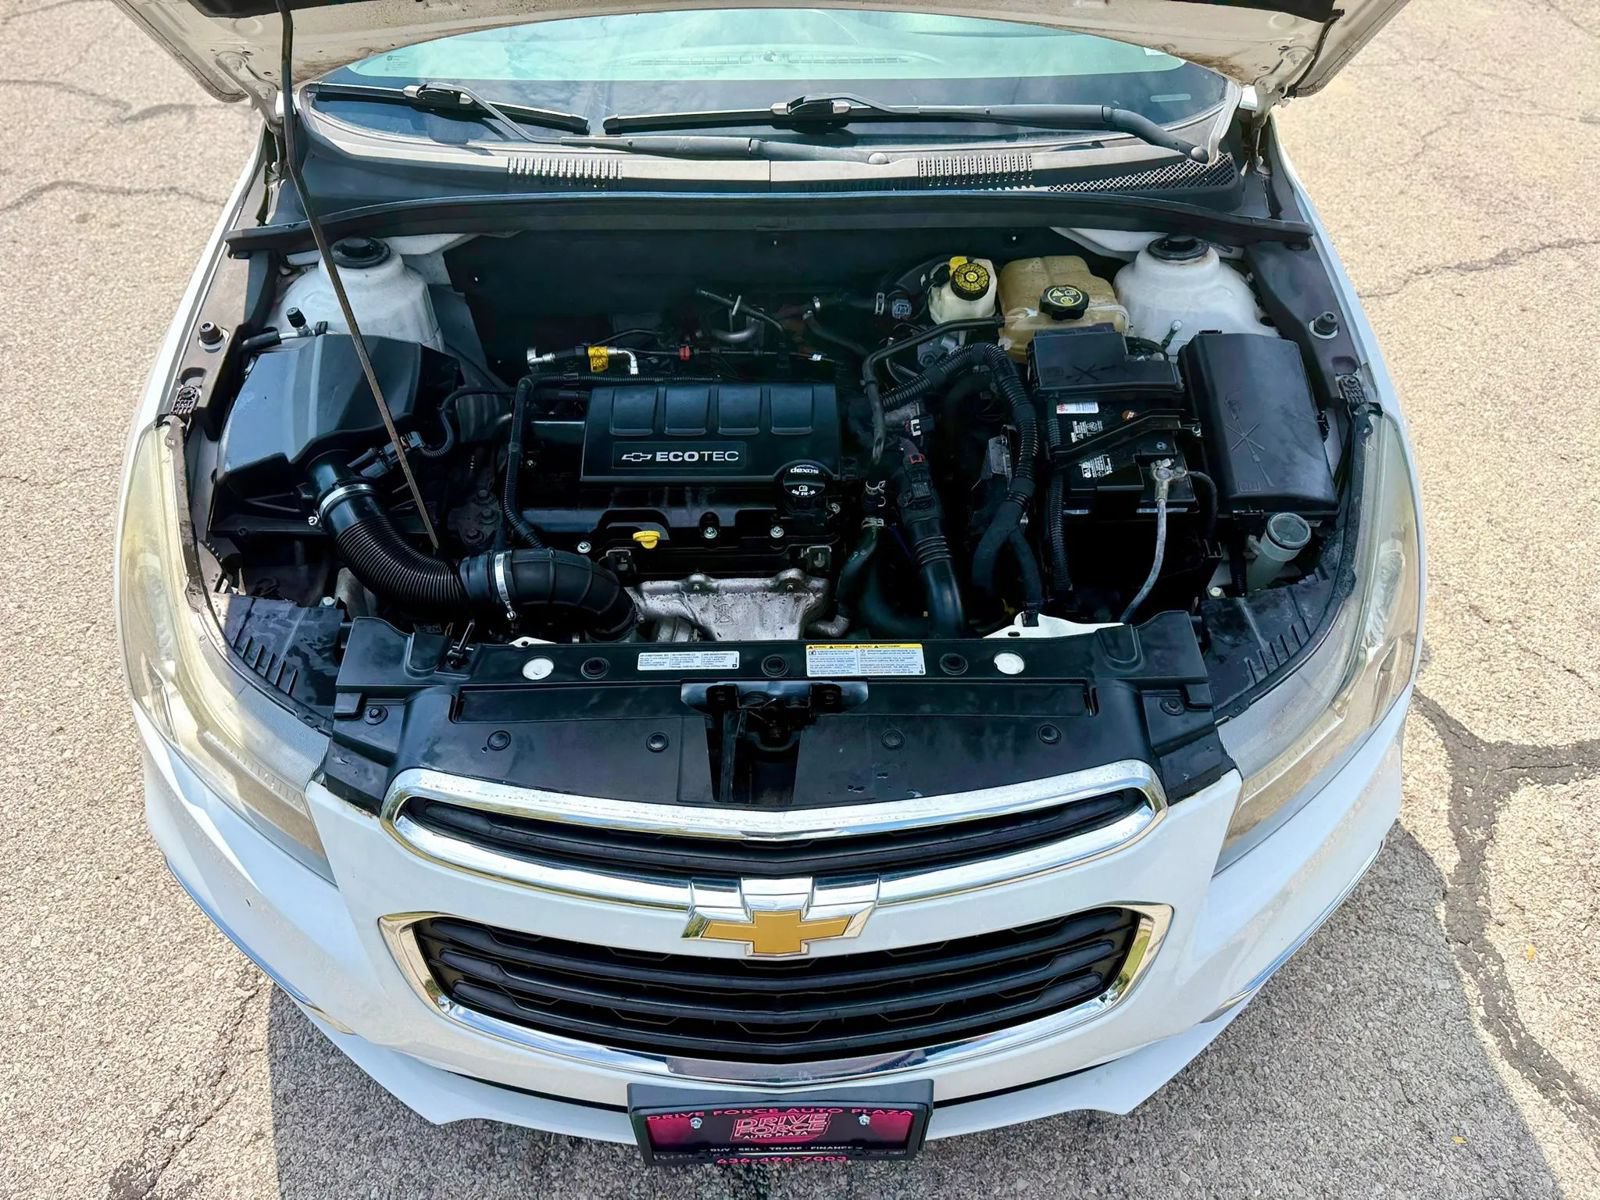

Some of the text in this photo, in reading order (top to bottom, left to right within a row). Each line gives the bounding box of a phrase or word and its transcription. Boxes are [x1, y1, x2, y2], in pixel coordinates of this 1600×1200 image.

[655, 450, 739, 462] ECOTEC
[790, 464, 819, 474] dexos
[646, 1111, 705, 1121] DRIVE
[713, 1108, 779, 1116] FORCE
[851, 1108, 913, 1116] PLAZA
[736, 1112, 829, 1128] DRIVE
[734, 1121, 827, 1137] FORCE
